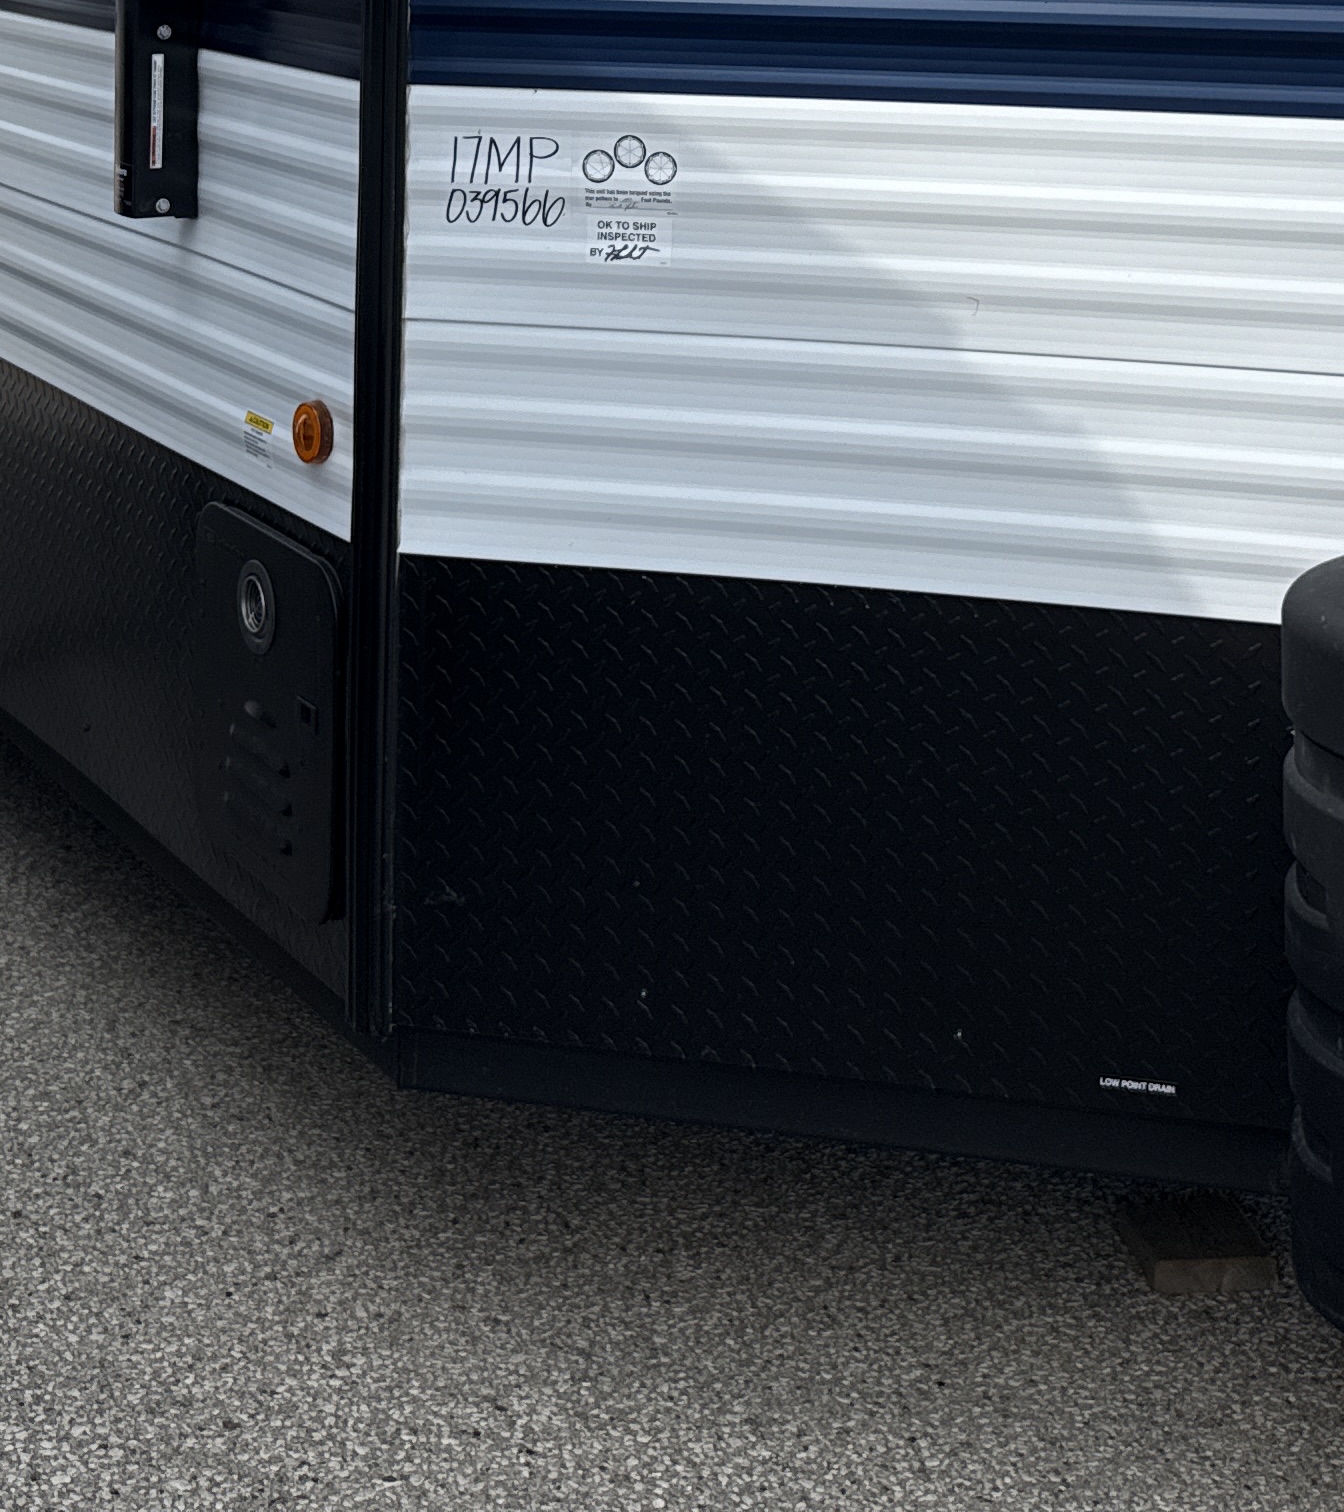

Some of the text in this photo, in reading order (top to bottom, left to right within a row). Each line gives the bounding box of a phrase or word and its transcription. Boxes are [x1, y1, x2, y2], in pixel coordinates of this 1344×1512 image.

[597, 220, 657, 231] OK TO SHIP
[597, 231, 657, 243] INSPECTED
[589, 247, 604, 257] BY
[1099, 1076, 1120, 1087] LOW
